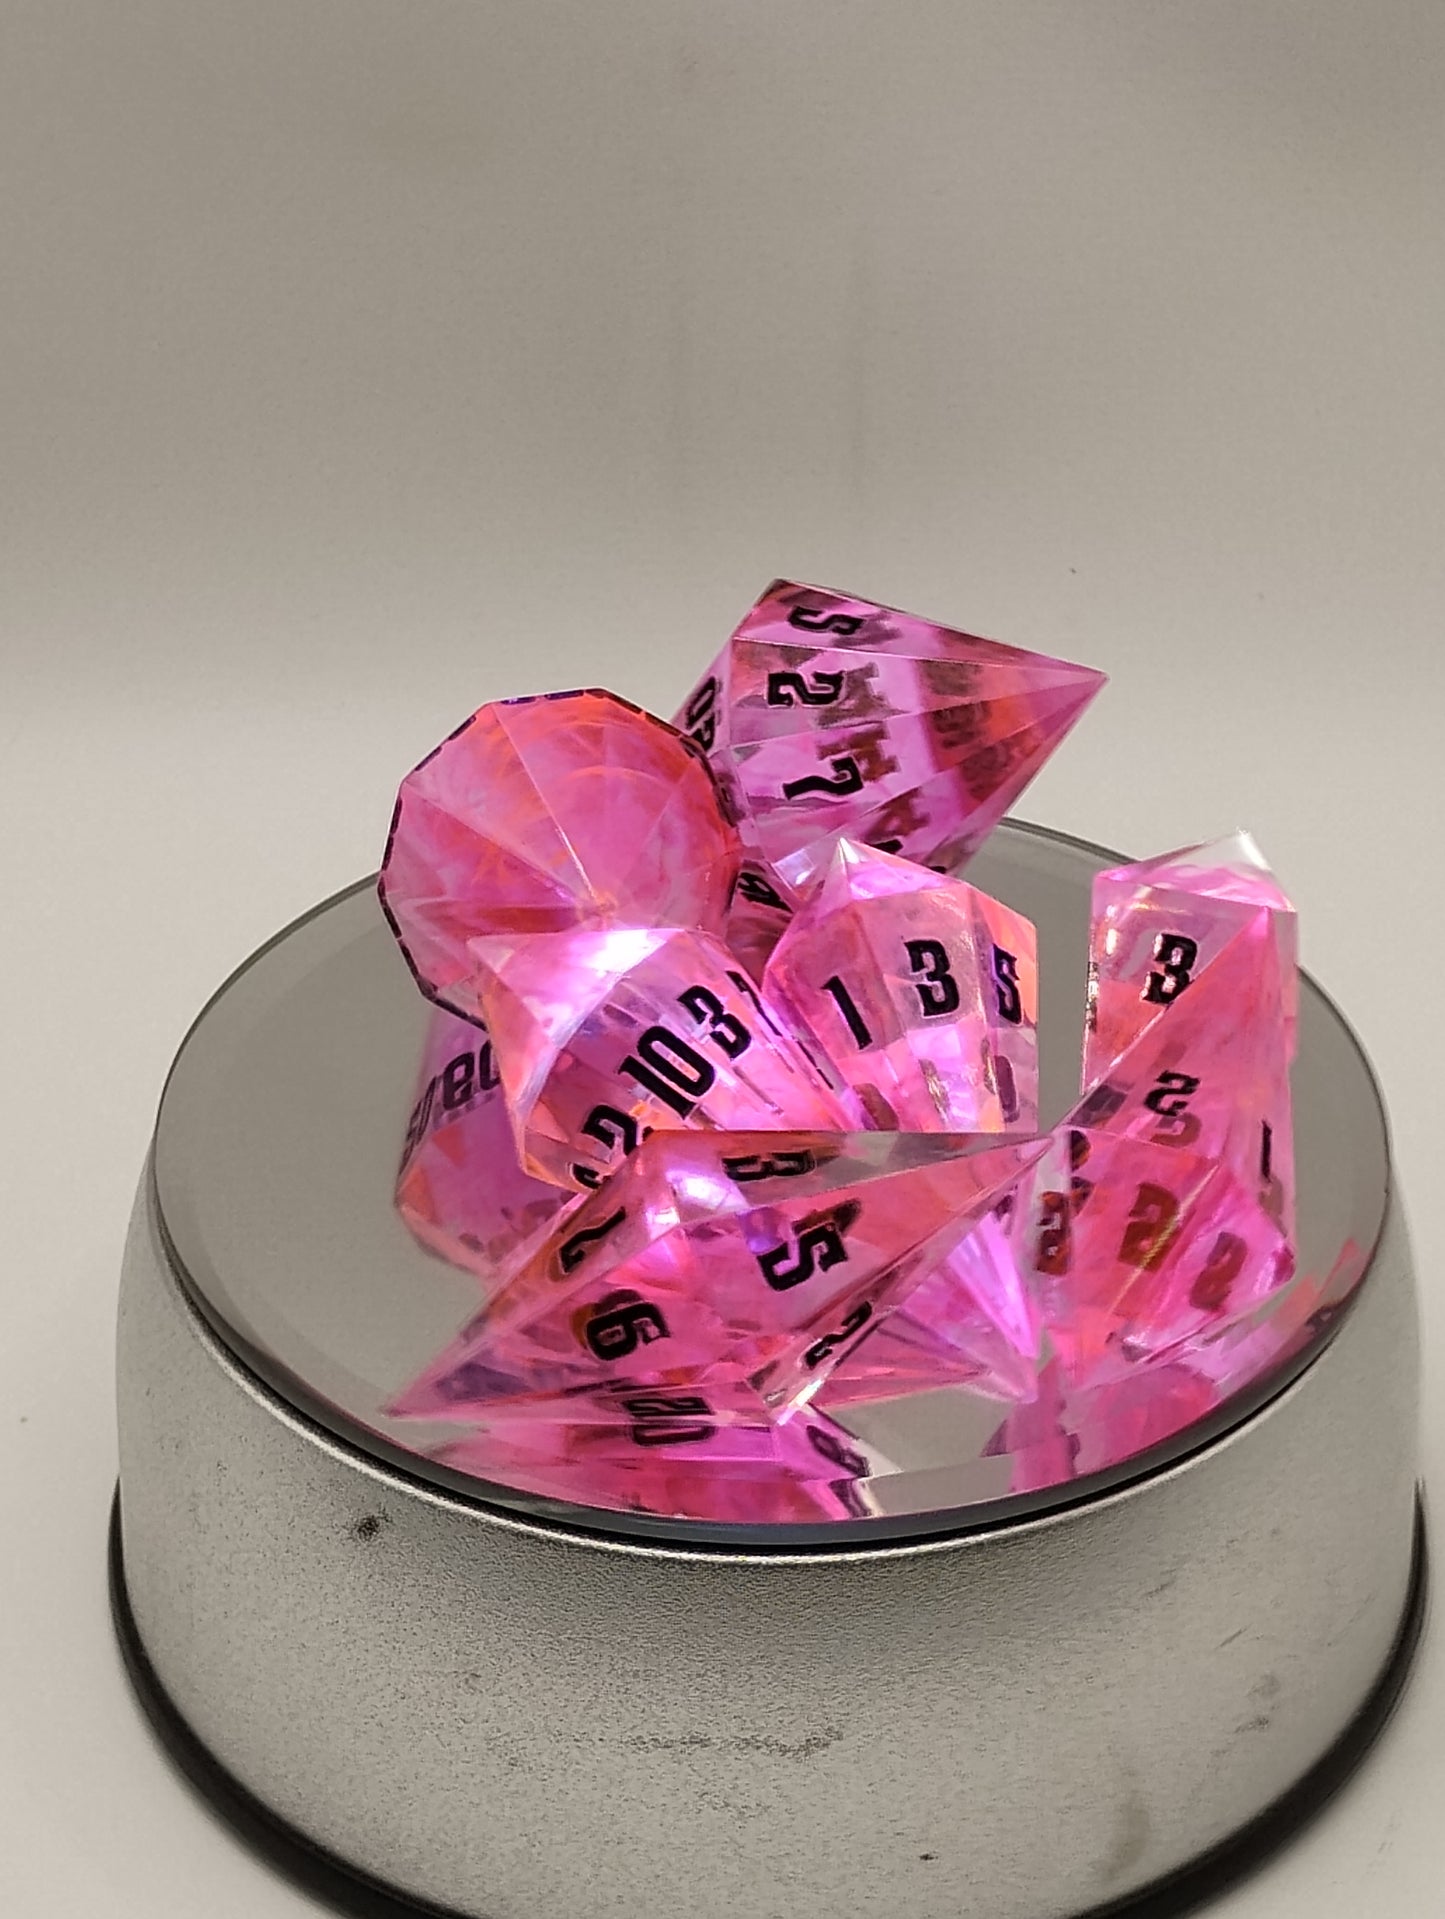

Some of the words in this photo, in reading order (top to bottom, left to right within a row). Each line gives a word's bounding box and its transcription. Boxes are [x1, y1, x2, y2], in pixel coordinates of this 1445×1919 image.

[766, 671, 846, 706] 2
[782, 756, 865, 801] 7
[904, 939, 960, 1017] 3
[992, 943, 1023, 1025] 5
[1141, 933, 1198, 1004] 3
[677, 985, 751, 1060] 3
[820, 975, 873, 1050] 1
[619, 1026, 717, 1120] 10
[722, 1150, 816, 1182] 3
[756, 1221, 849, 1291] 5
[586, 1301, 671, 1361] 6
